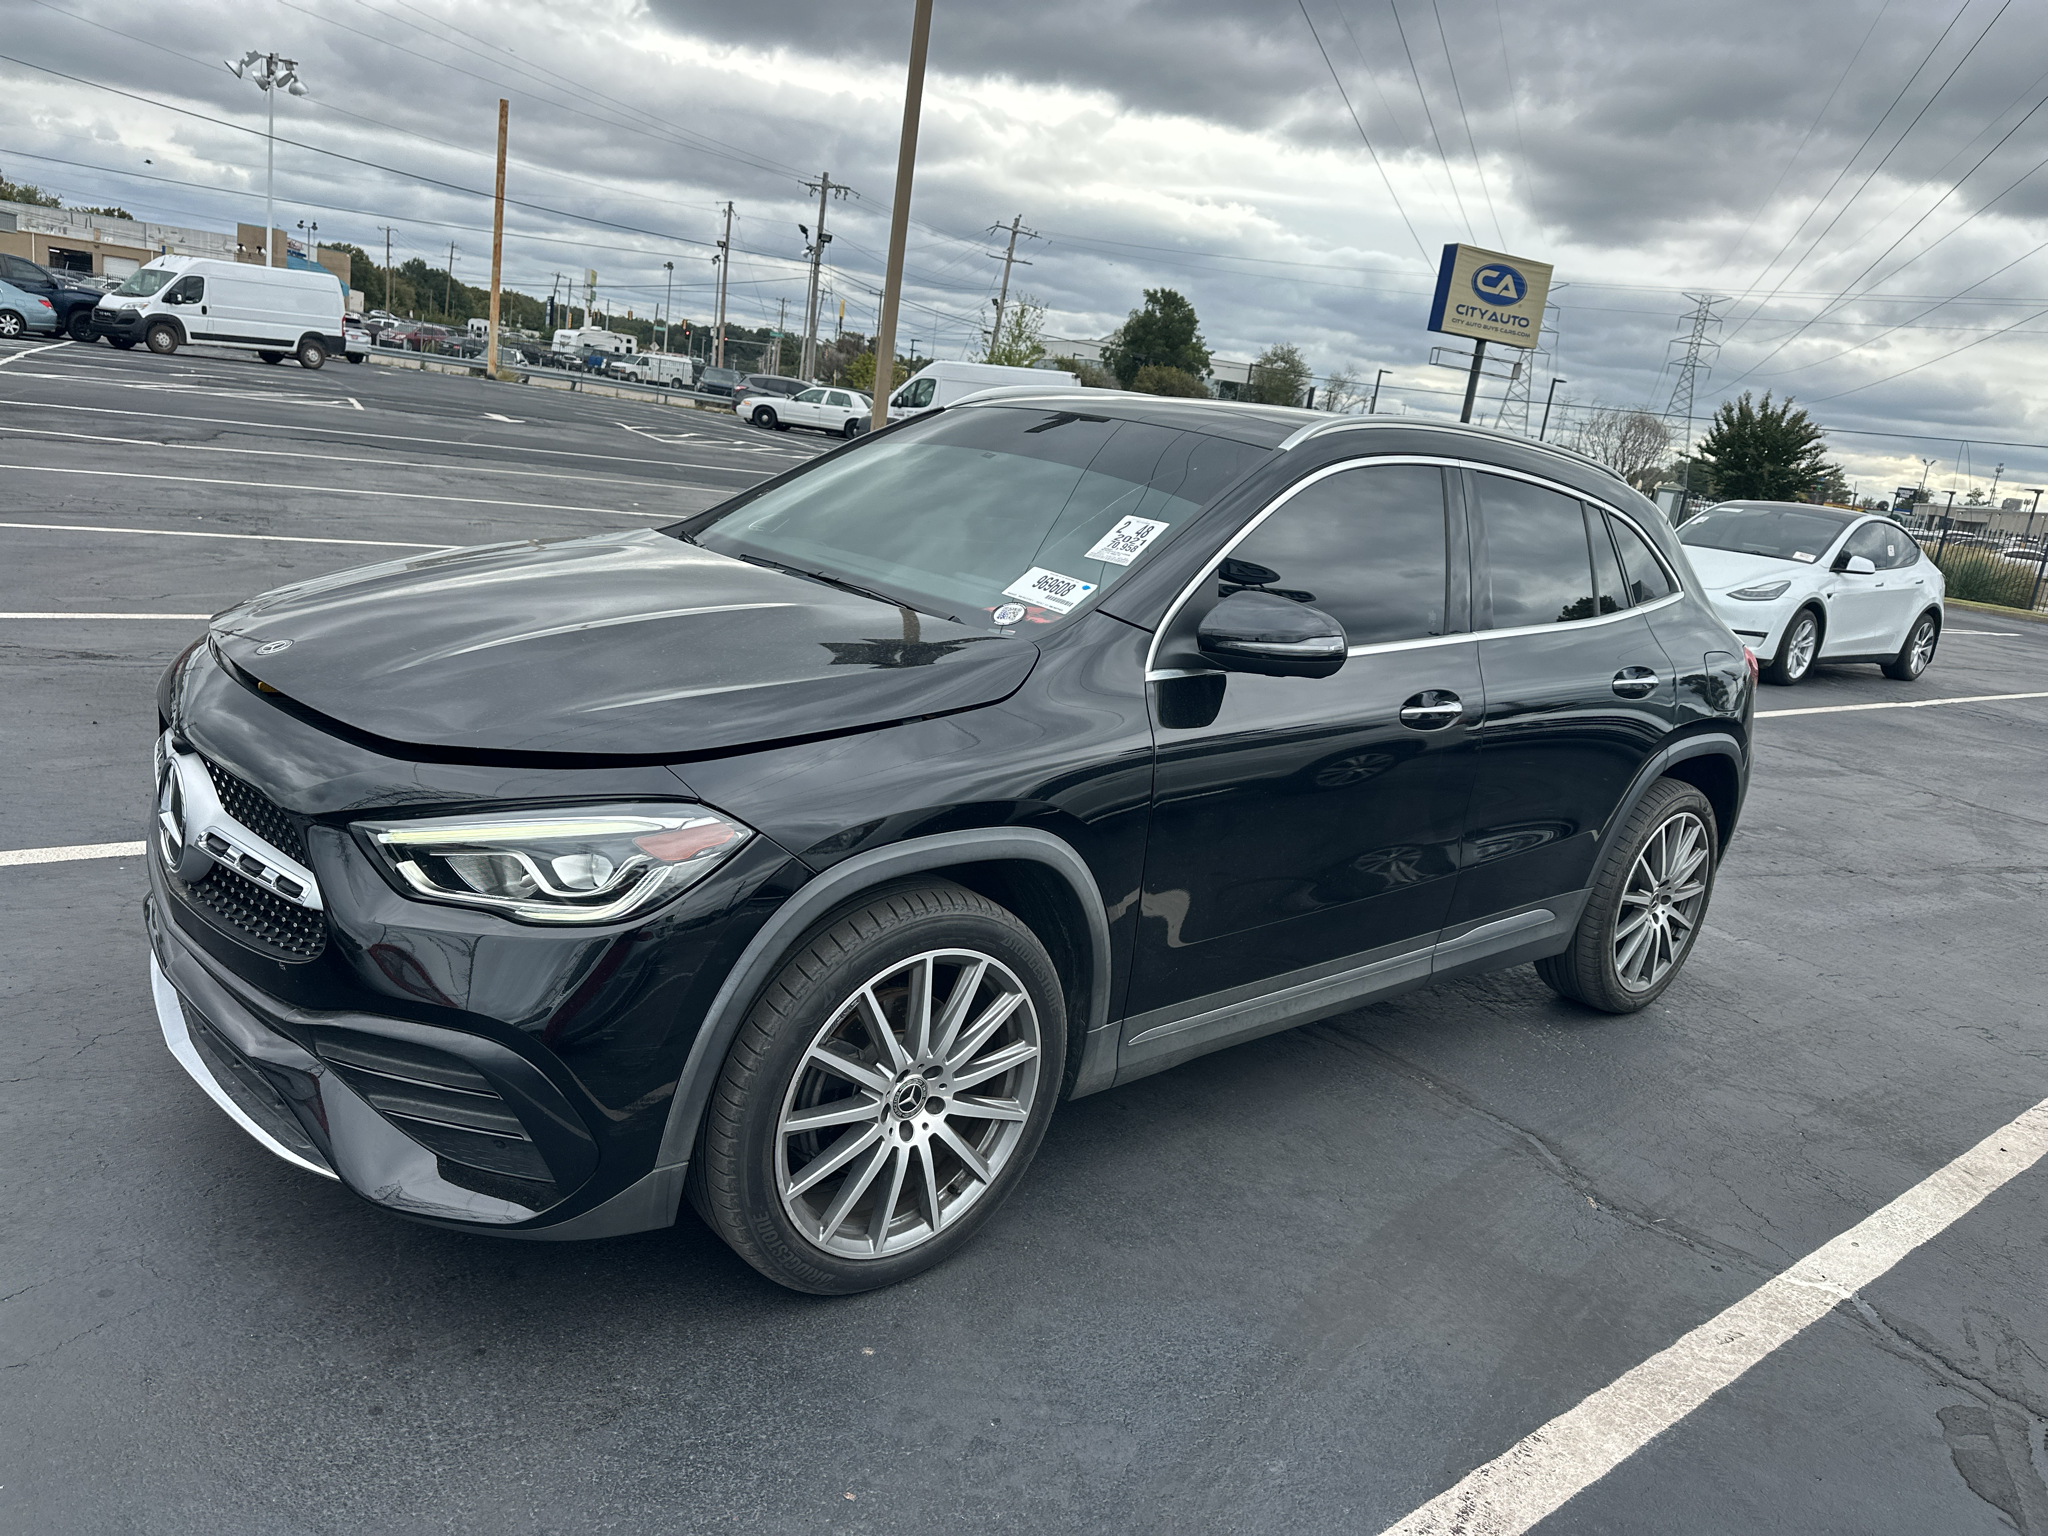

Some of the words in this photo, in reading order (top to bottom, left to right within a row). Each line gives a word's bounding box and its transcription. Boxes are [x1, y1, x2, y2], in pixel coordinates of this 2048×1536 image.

[1476, 269, 1519, 299] CA
[1451, 317, 1466, 325] CITY
[1465, 321, 1482, 329] AUTO
[1482, 324, 1499, 332] BUYS
[1500, 327, 1531, 338] CARS.COM
[1113, 534, 1148, 546] 2021
[1115, 520, 1132, 534] 2
[1135, 524, 1155, 539] 48
[1032, 575, 1076, 597] 969608
[1000, 935, 1059, 1014] BRIDGESTONE
[753, 1211, 837, 1288] BRIDGESTONE
